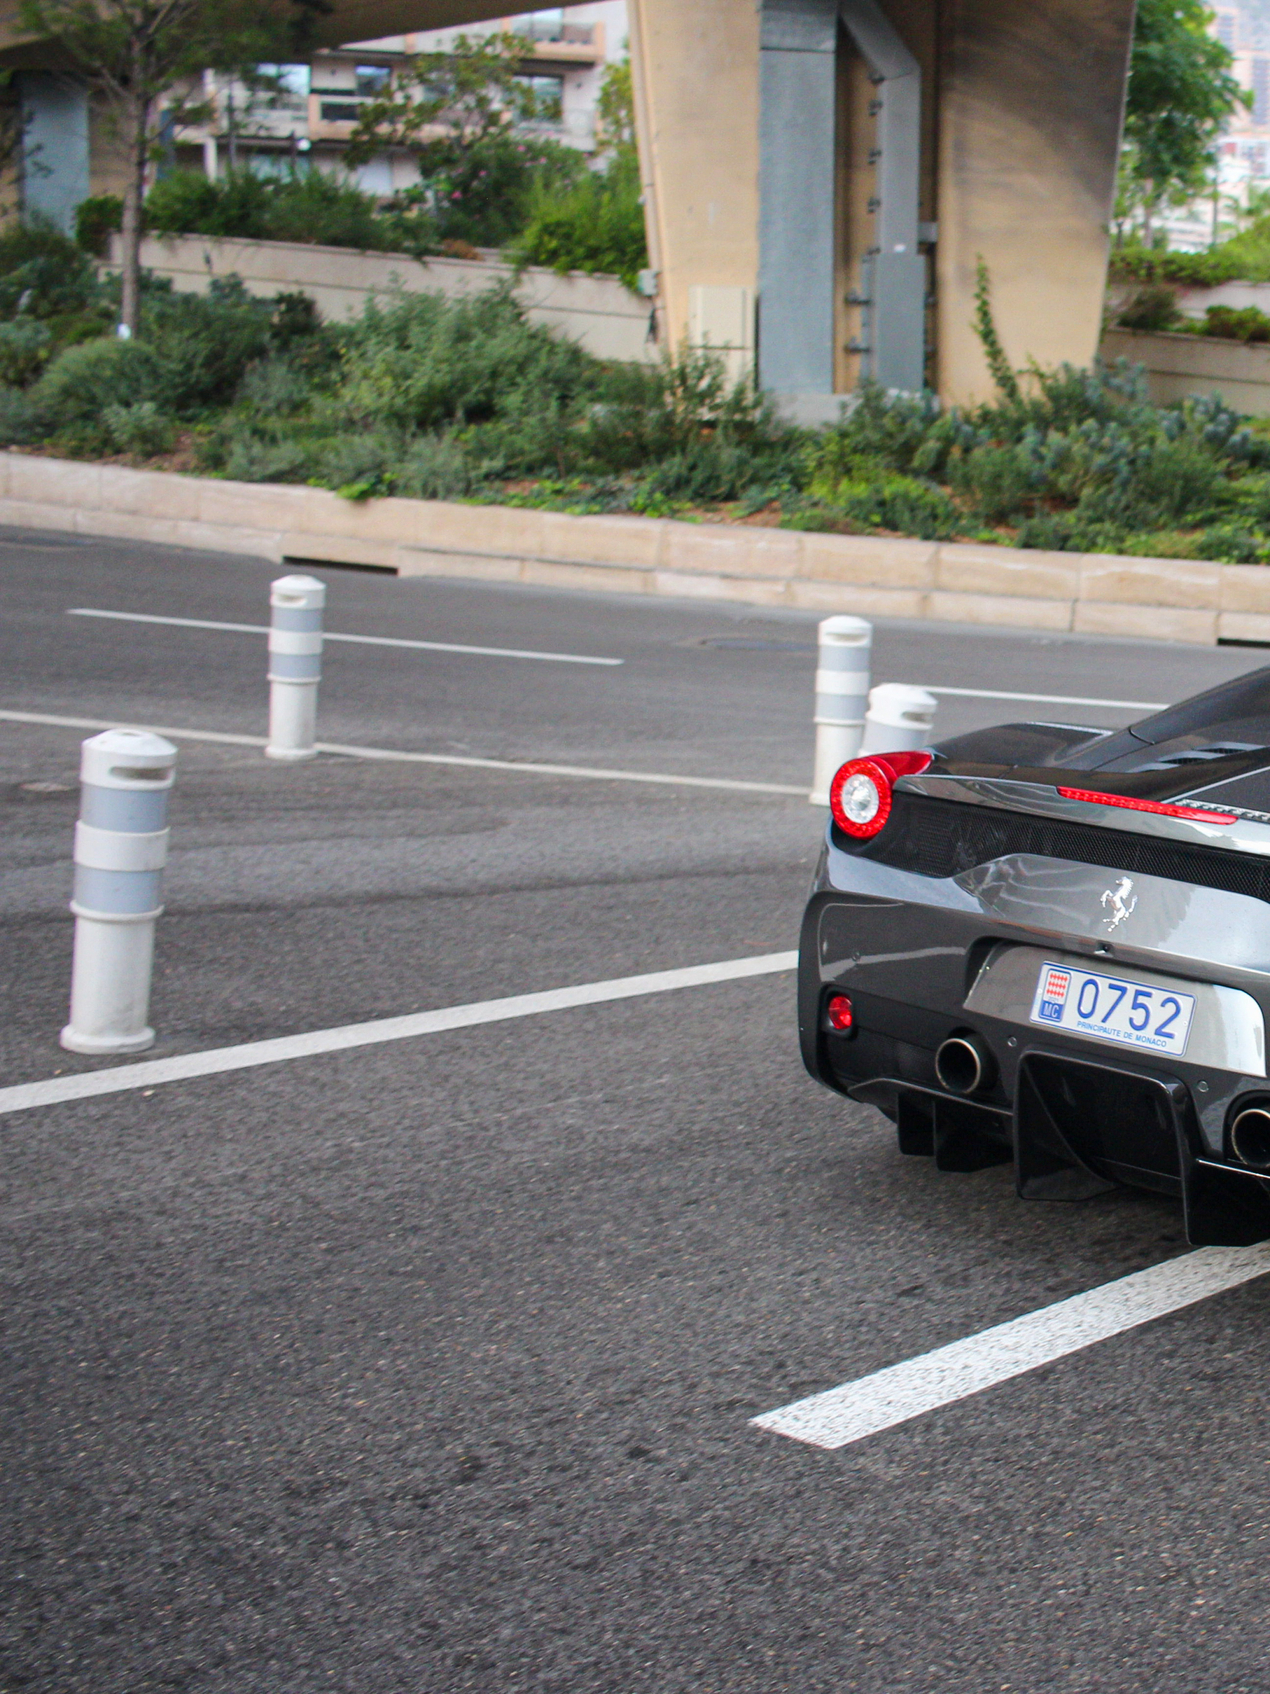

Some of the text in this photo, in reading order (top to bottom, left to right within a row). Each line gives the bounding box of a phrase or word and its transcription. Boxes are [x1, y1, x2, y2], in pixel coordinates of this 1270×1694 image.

[1042, 1002, 1059, 1018] MC
[1077, 978, 1181, 1039] 0752
[1077, 1020, 1167, 1048] PRINCIPAUTE DE MONACO
